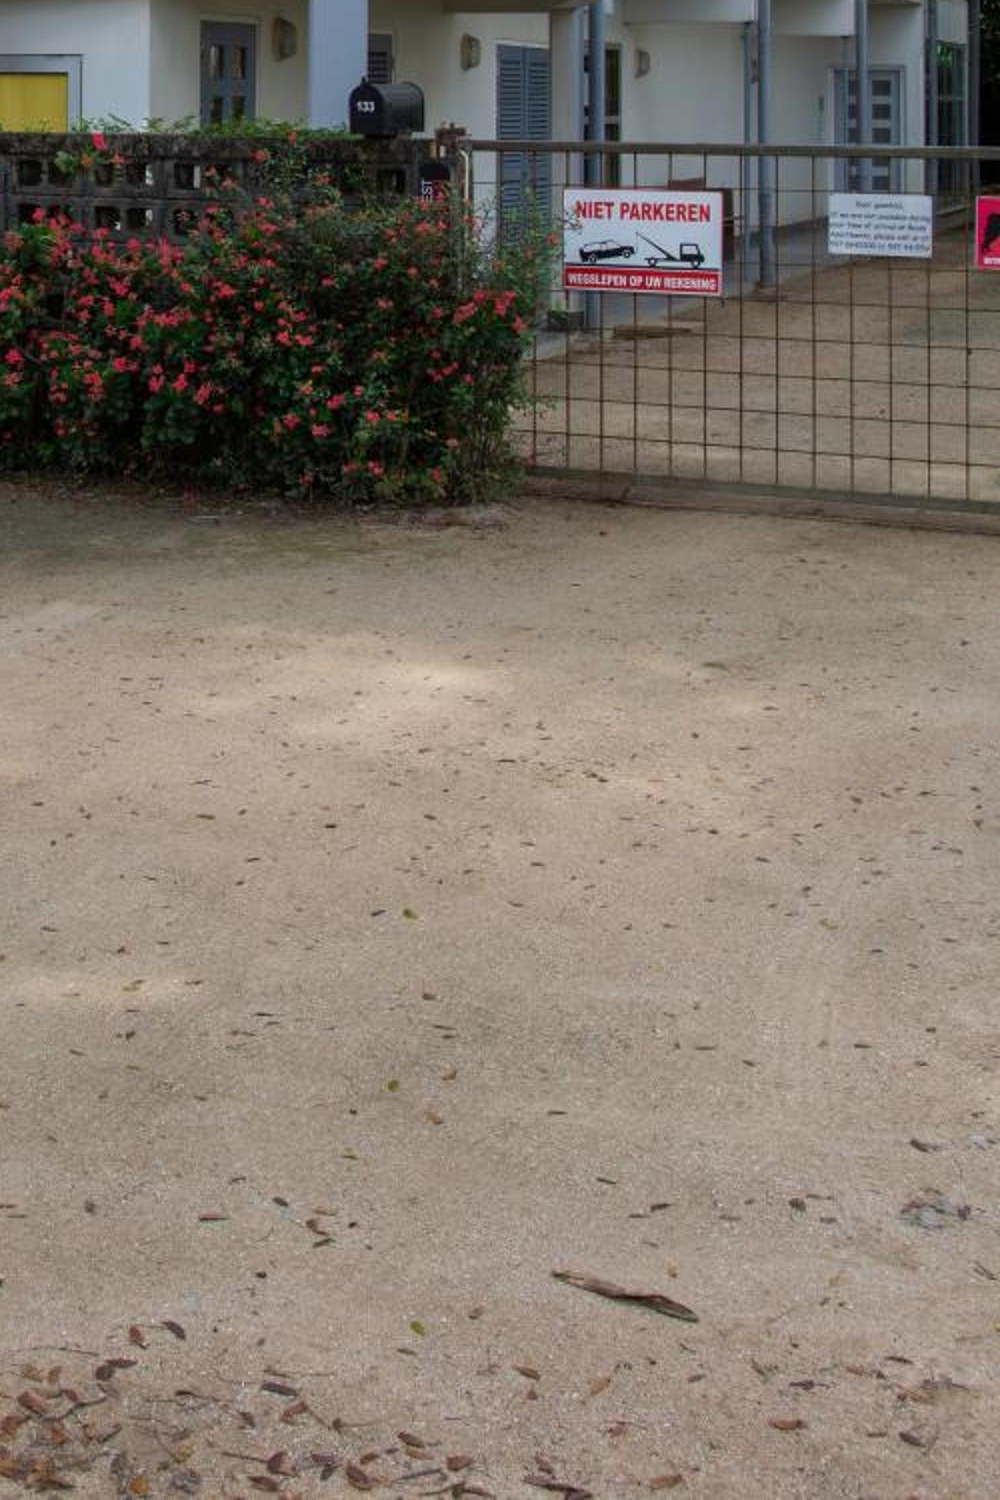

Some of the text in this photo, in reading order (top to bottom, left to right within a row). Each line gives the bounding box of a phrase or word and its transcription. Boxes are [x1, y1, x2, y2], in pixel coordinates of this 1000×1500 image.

[357, 101, 376, 112] 133
[575, 201, 711, 222] NIET PARKEREN
[567, 273, 717, 291] WEGSLEPEN OP UW REKENING
